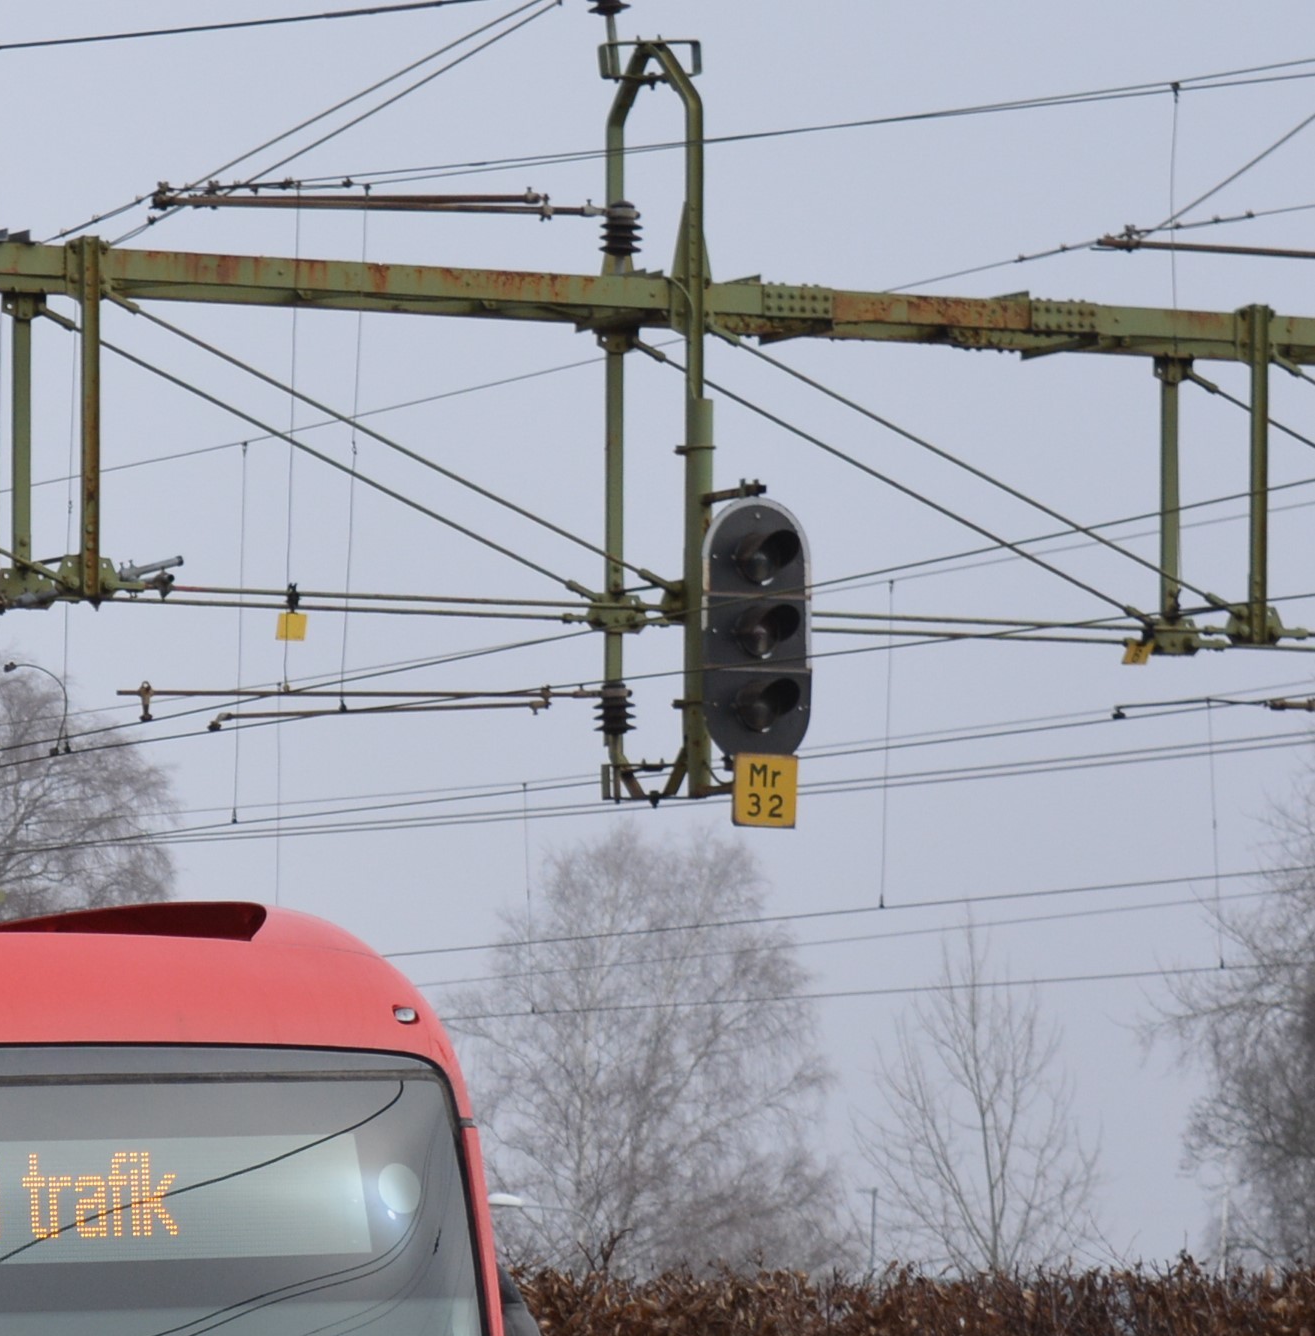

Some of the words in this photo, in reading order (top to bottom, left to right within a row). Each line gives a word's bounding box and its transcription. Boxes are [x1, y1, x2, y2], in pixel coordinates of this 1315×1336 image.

[749, 763, 781, 788] Mr
[746, 793, 783, 818] 32
[22, 1152, 178, 1238] trafik
